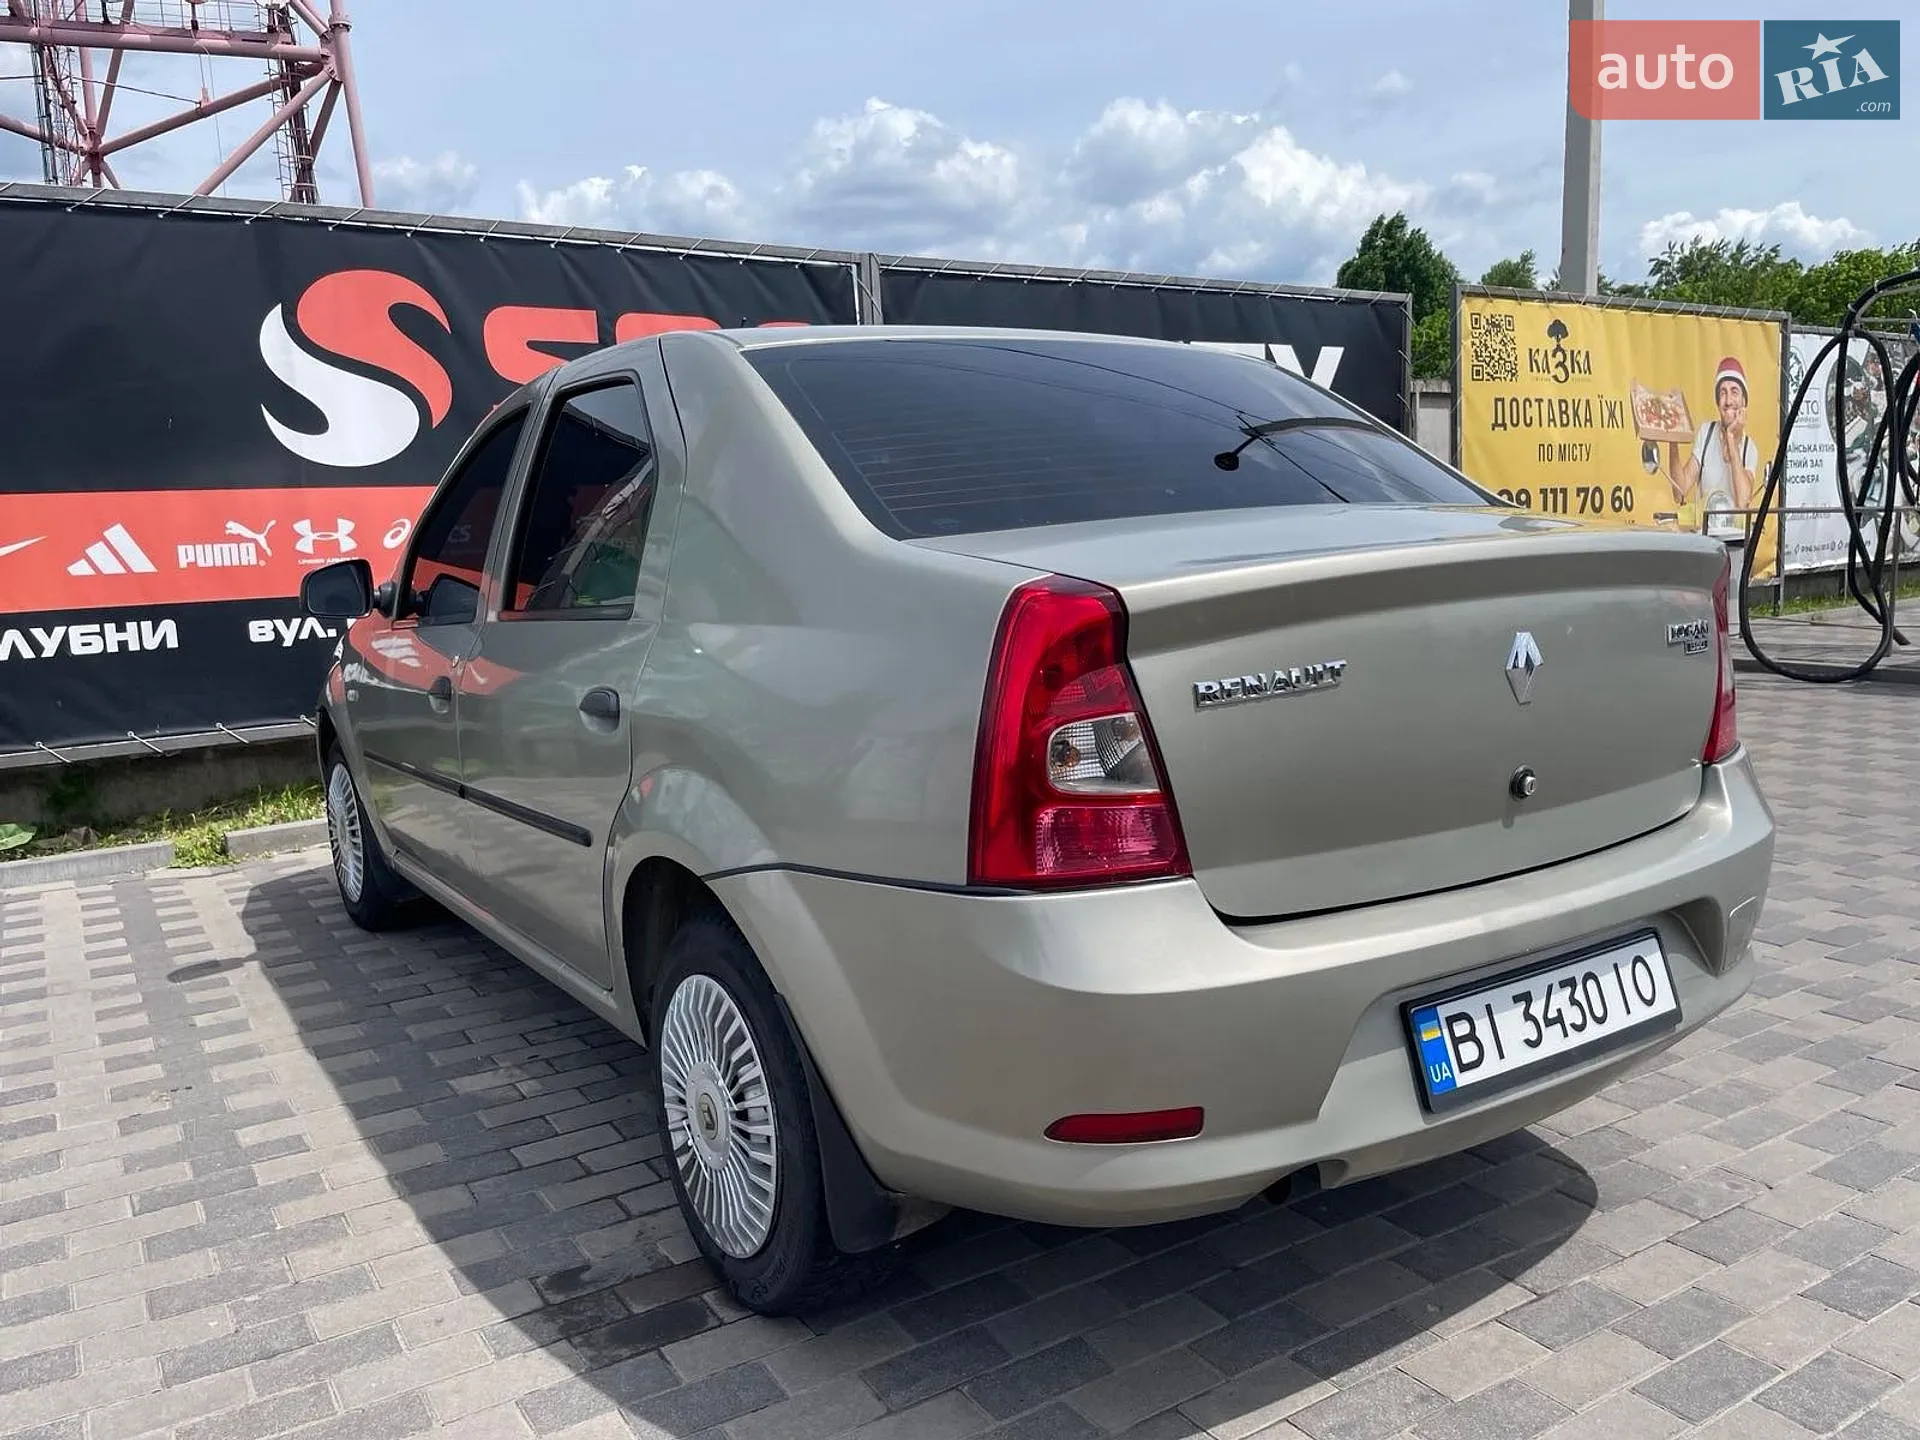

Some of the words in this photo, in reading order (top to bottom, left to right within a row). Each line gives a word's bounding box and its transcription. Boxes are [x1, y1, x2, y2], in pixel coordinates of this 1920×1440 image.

[1491, 397, 1593, 431] ДОСТАВКА
[1598, 394, 1625, 429] ЇЖІ
[1538, 443, 1553, 462] ПО
[1557, 443, 1592, 462] МІСТУ
[1785, 456, 1808, 469] ЕТНИЙ
[1539, 487, 1568, 514] 111
[1576, 486, 1604, 514] 70
[1610, 485, 1634, 513] 60
[177, 542, 259, 569] PUMA
[0, 619, 179, 661] ЛУБНИ
[1194, 658, 1348, 708] RENAULT
[1445, 1003, 1505, 1074] BI
[1512, 971, 1608, 1049] 3430
[1613, 954, 1656, 1016] IO
[1429, 1061, 1453, 1083] UA
